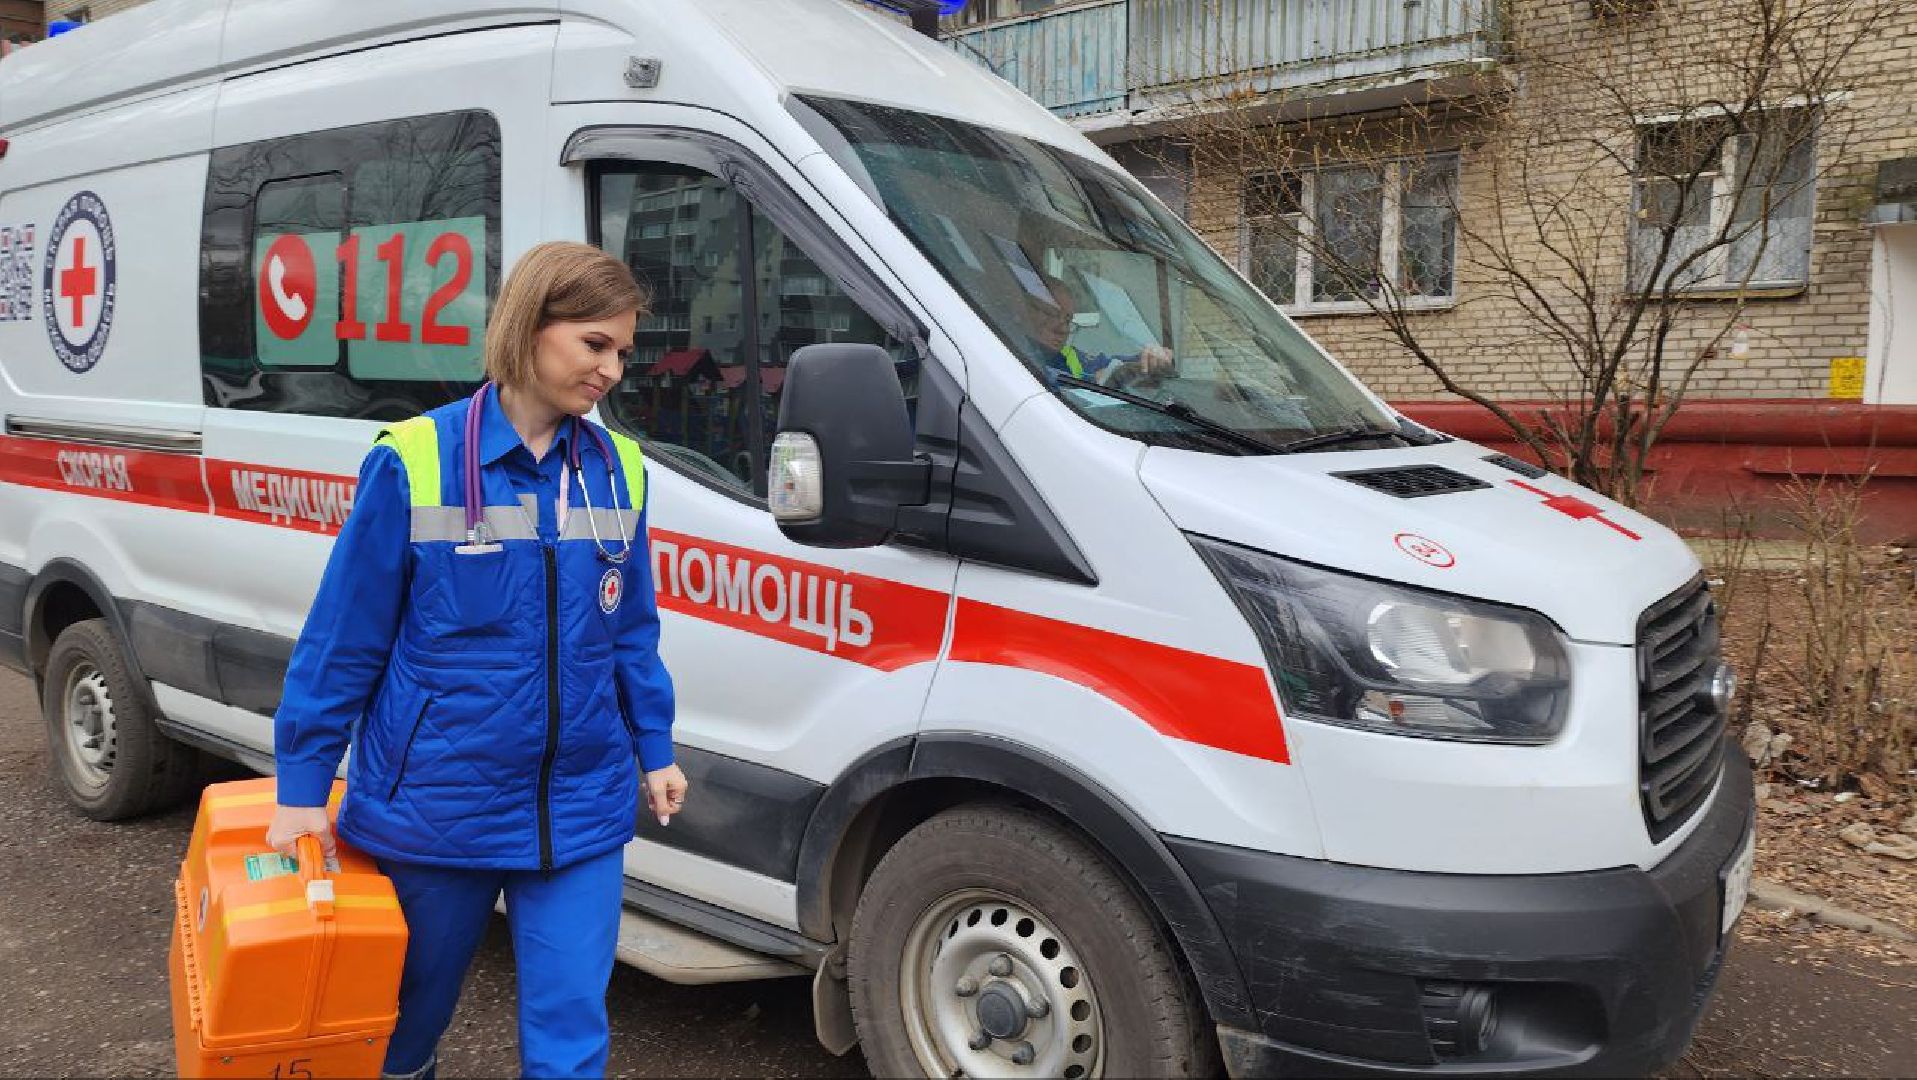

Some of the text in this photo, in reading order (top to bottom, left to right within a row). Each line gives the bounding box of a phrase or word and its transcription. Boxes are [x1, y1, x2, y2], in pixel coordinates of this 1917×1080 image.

[335, 231, 473, 346] 112
[57, 449, 134, 492] СКОРАЯ
[231, 469, 357, 531] МЕДИЦИН
[651, 539, 874, 652] ПОМОЩЬ
